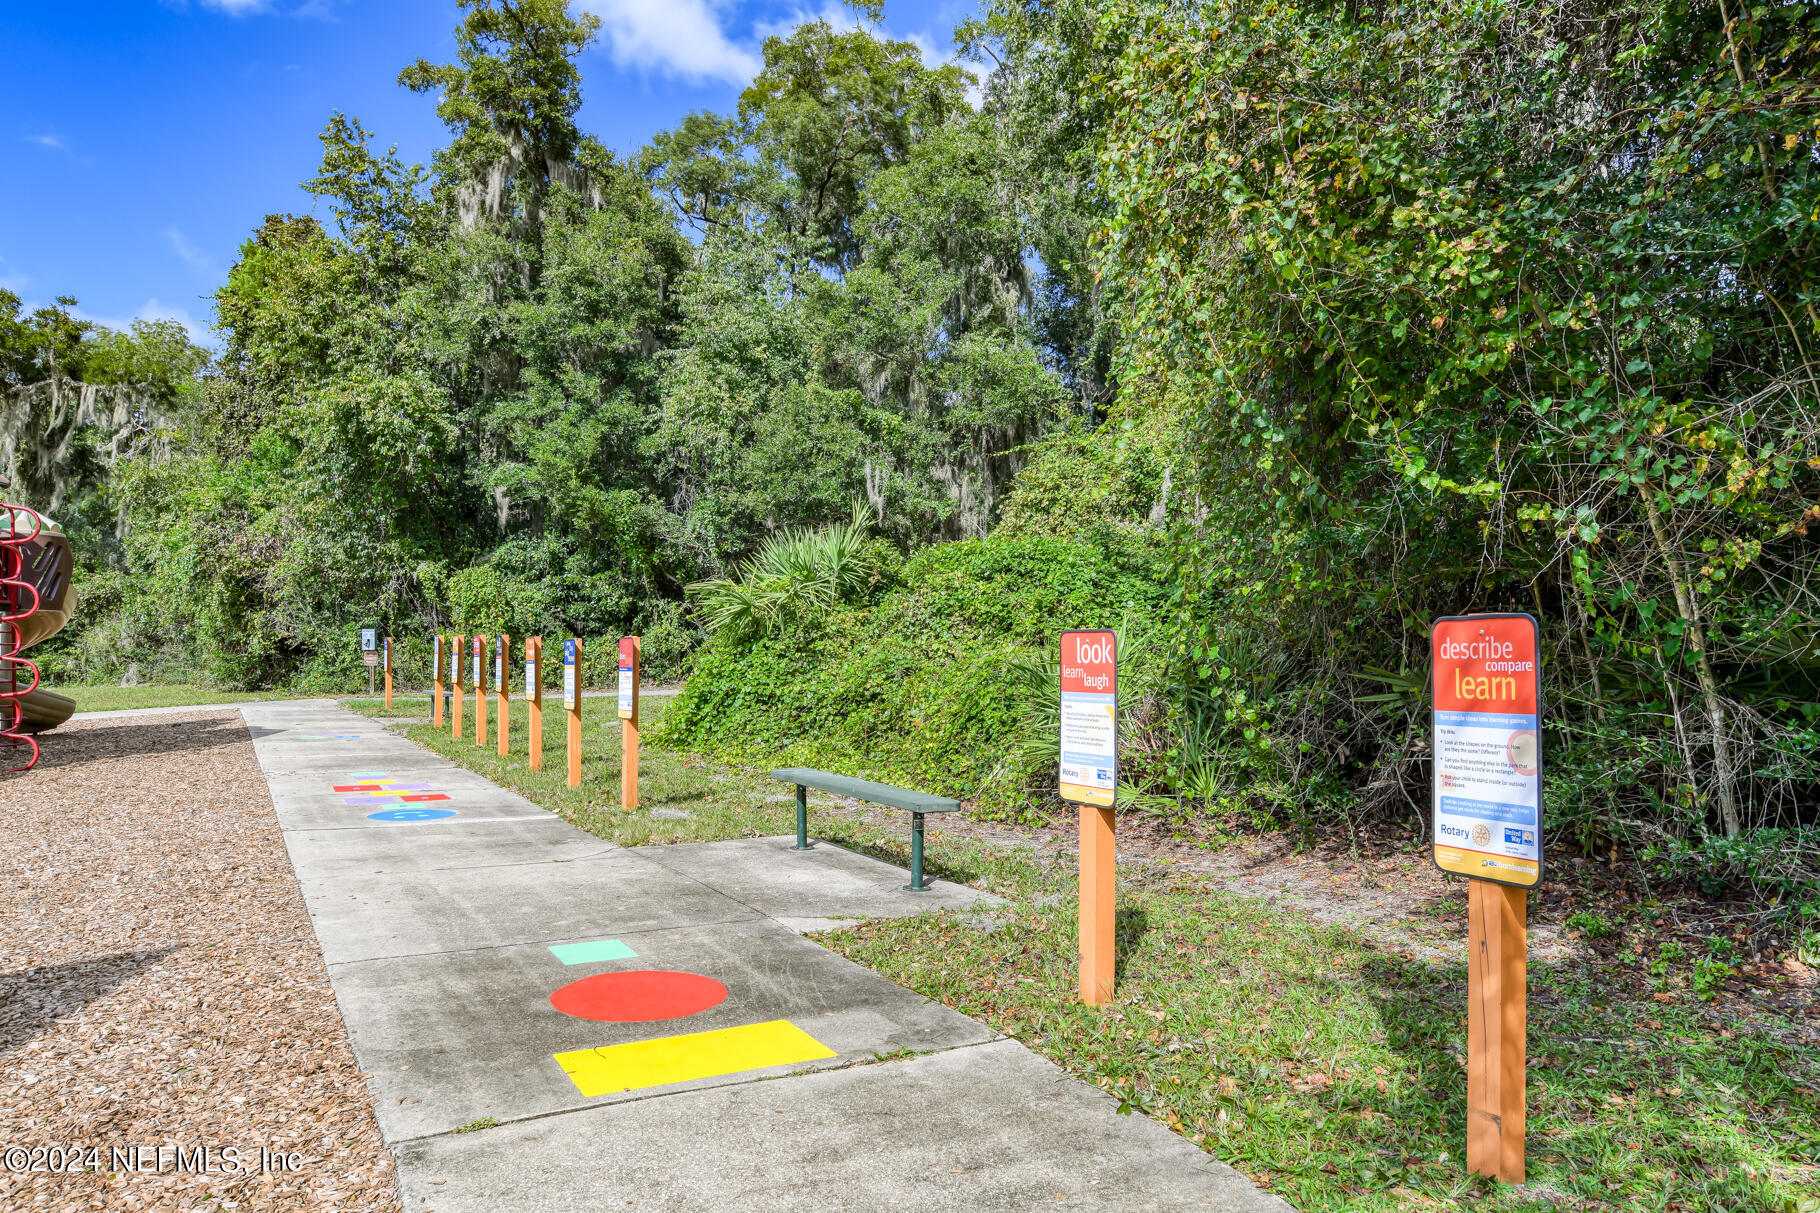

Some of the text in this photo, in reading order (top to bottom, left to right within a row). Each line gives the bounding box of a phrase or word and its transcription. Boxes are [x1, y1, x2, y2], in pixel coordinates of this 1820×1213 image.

[1076, 636, 1113, 664] look
[1440, 635, 1513, 660] describe
[1063, 664, 1084, 679] learn
[1485, 661, 1533, 675] compare
[1083, 672, 1109, 690] laugh
[1455, 668, 1516, 700] learn
[1469, 759, 1486, 767] anything
[1440, 823, 1470, 840] Rotary
[1505, 829, 1521, 837] United
[1511, 836, 1521, 844] Way
